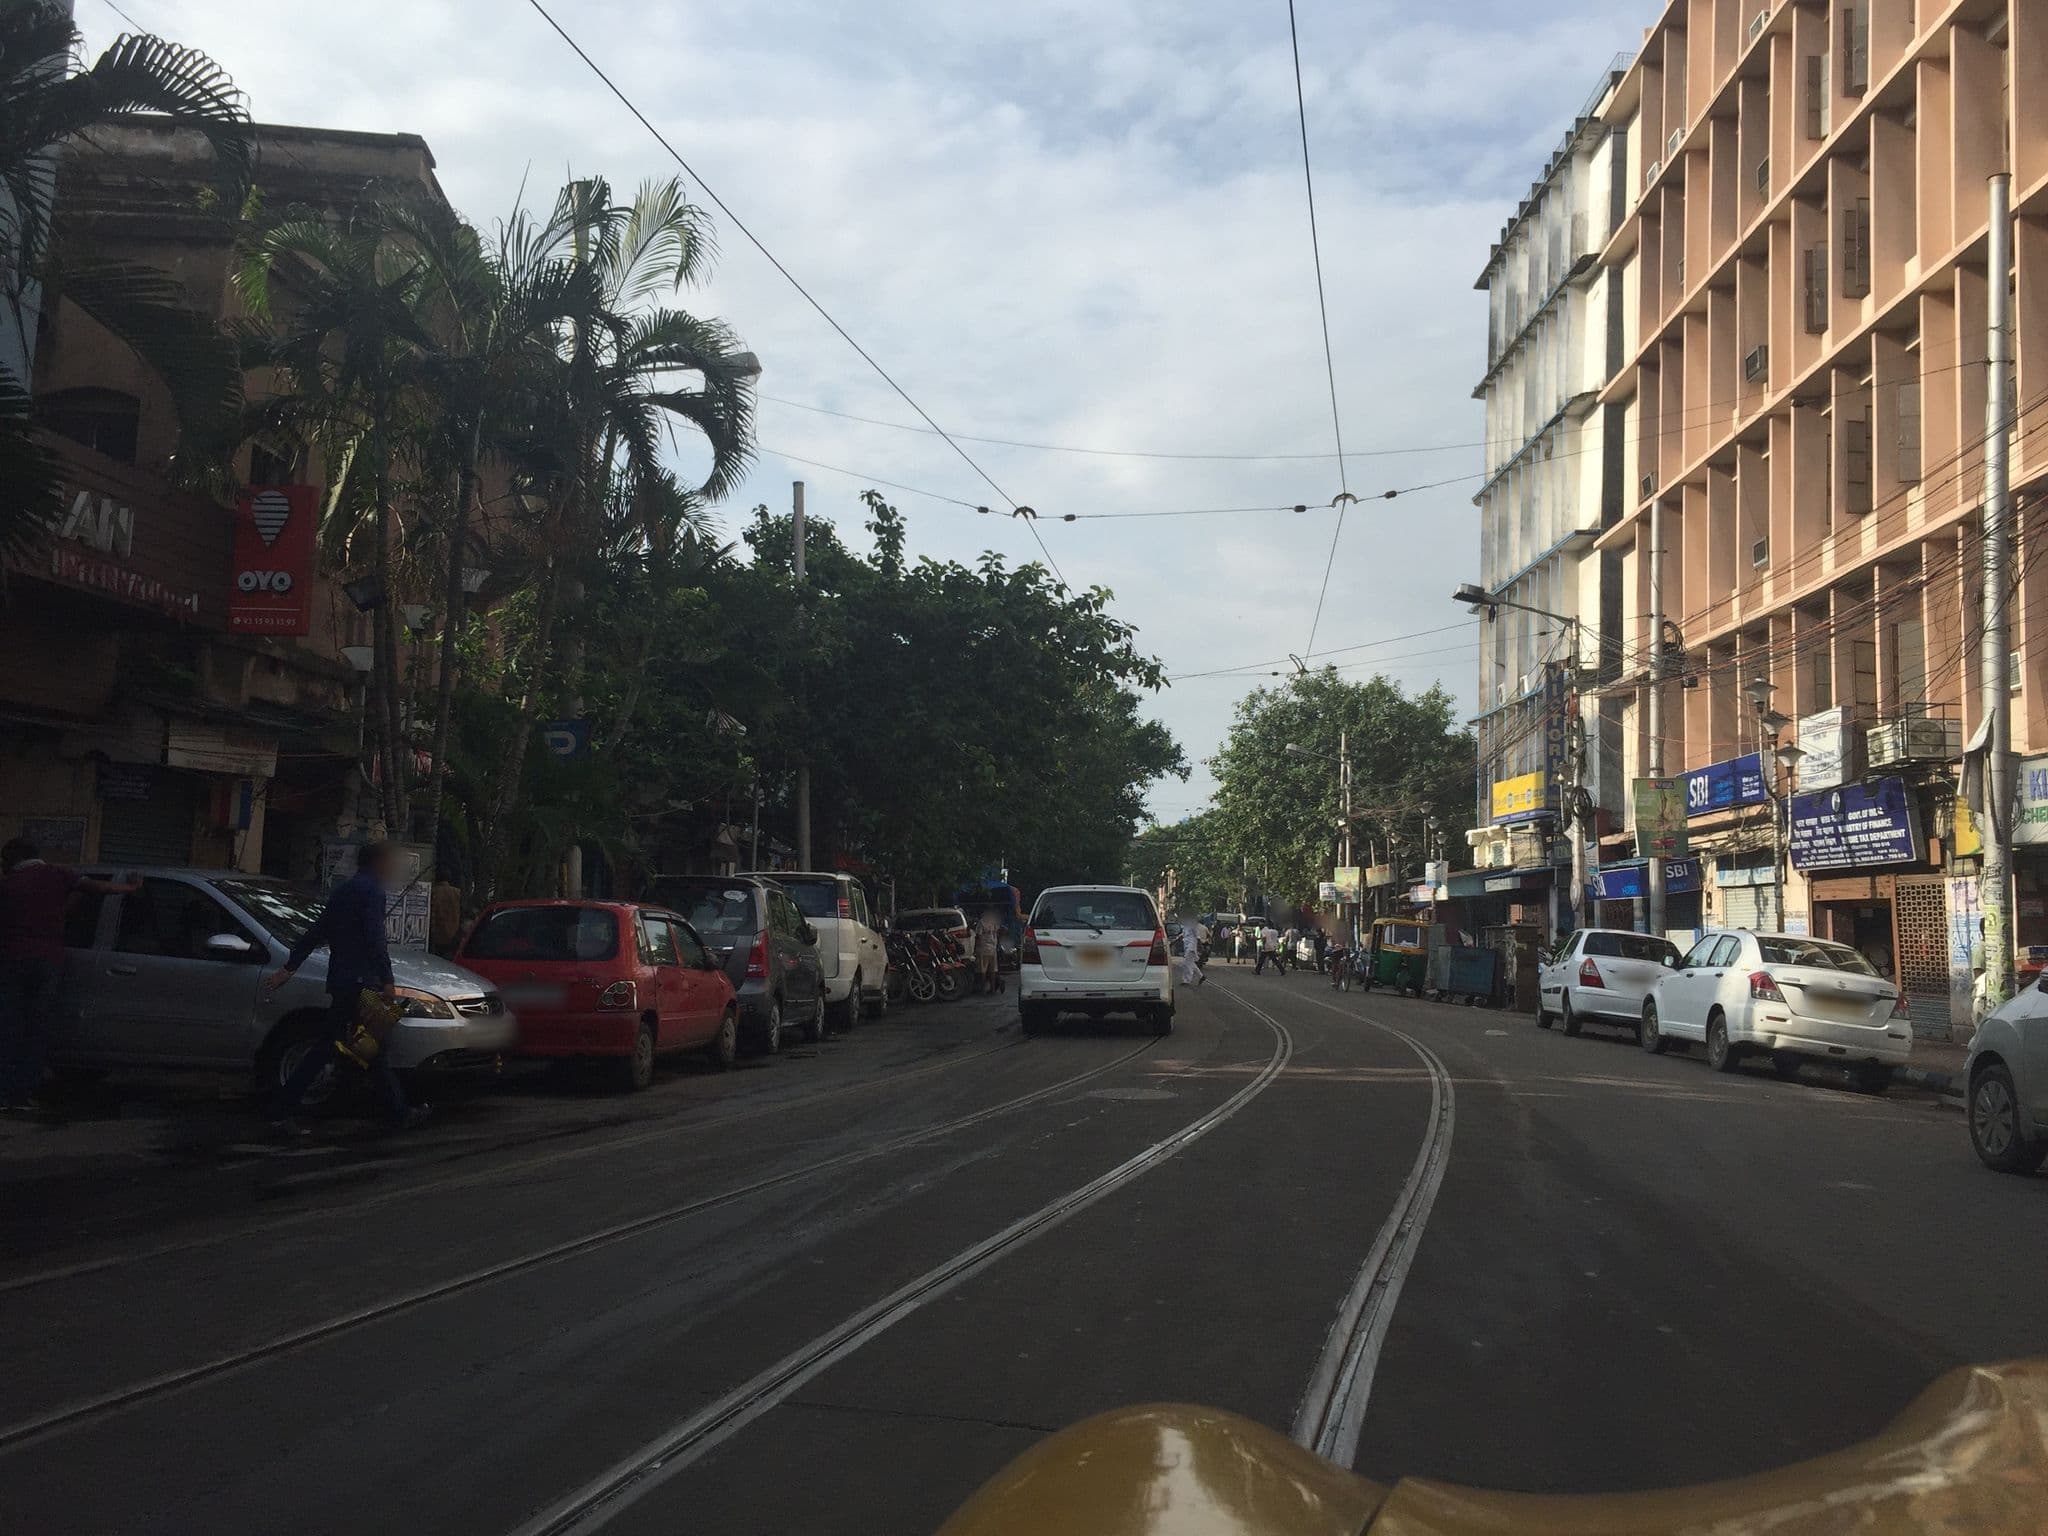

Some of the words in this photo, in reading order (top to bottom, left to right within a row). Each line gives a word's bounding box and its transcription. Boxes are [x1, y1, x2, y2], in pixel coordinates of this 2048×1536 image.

[238, 571, 292, 591] OYO
[1689, 775, 1709, 808] SBI
[1869, 828, 1906, 842] DEPARTMENT
[1666, 864, 1688, 878] SBI
[1592, 875, 1607, 897] SBI
